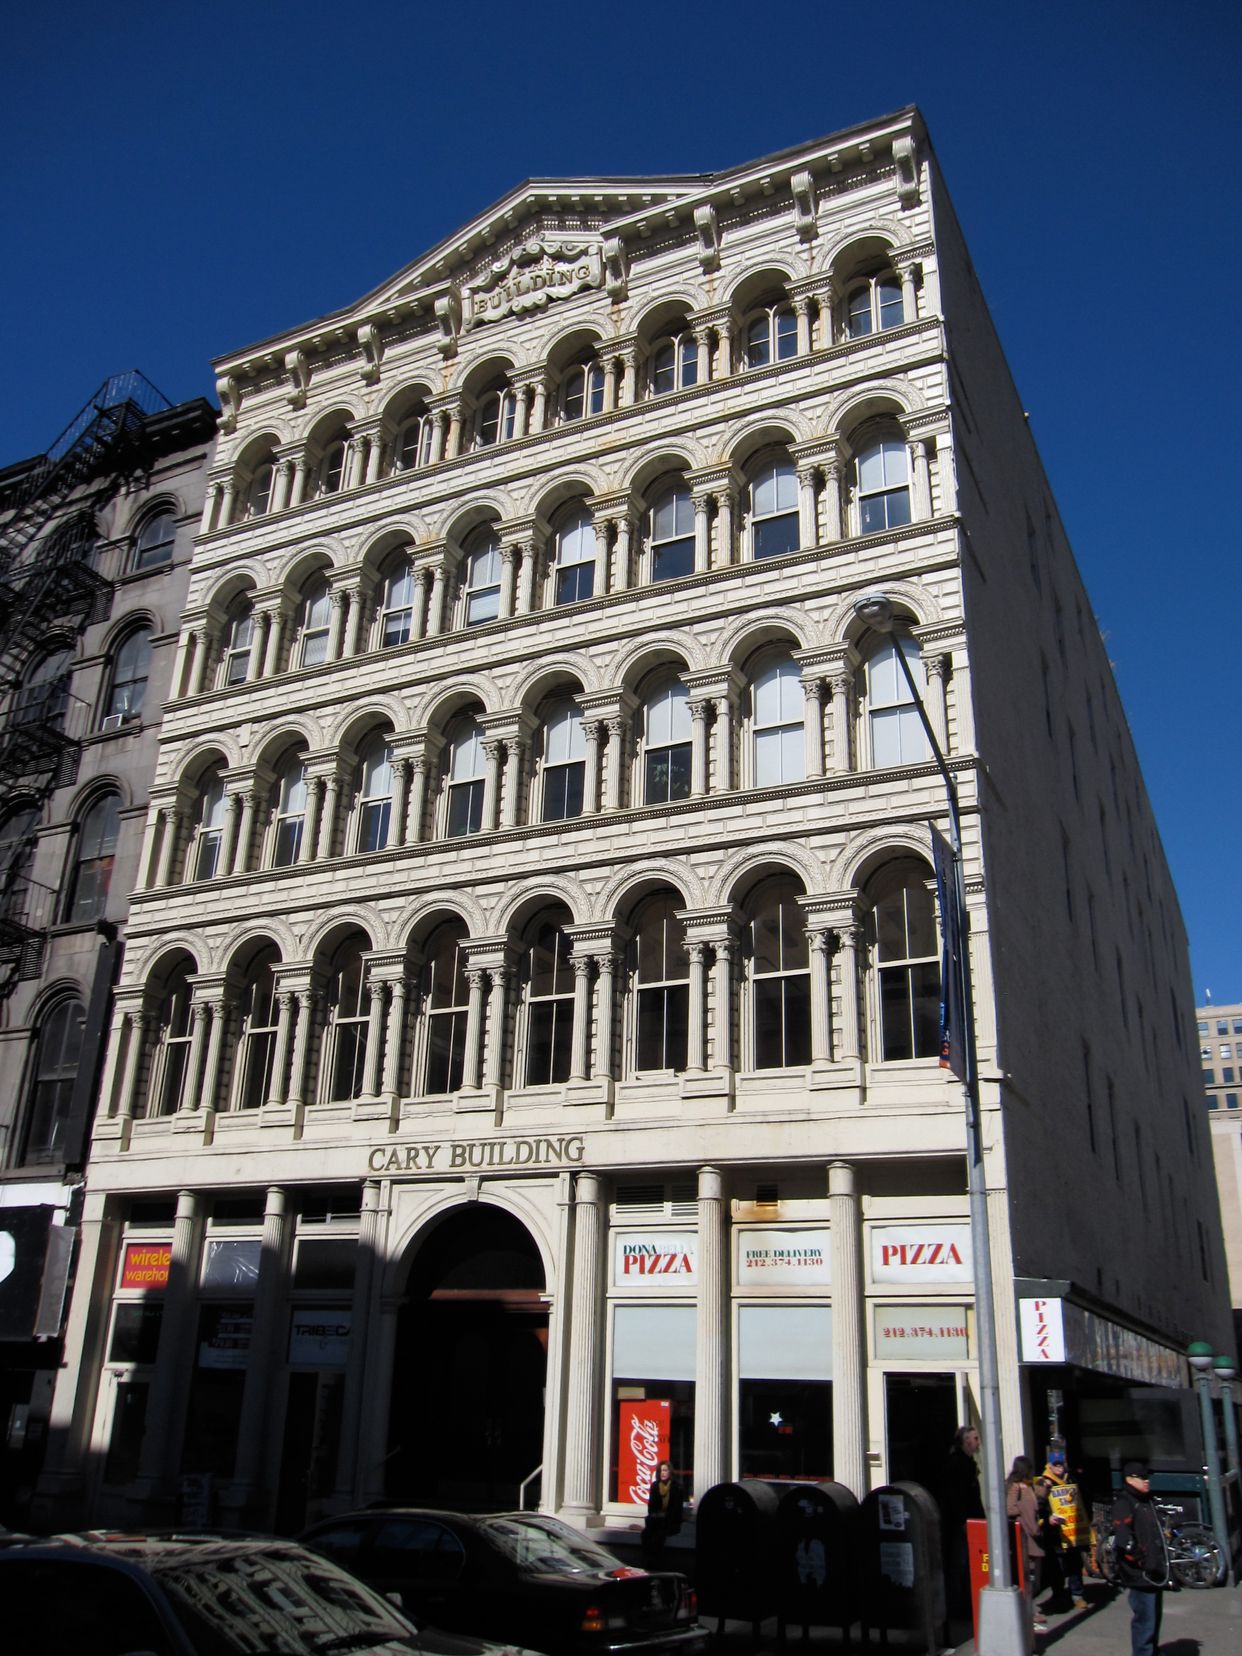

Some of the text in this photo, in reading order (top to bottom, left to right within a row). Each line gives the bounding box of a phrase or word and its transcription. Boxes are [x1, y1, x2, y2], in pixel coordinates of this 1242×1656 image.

[474, 264, 591, 315] BUILDING
[368, 1136, 586, 1171] CARY BUILDING
[130, 1249, 172, 1266] wirele
[623, 1253, 693, 1275] PIZZA
[746, 1248, 823, 1258] FREE DELIVERY
[746, 1258, 823, 1268] 212.374.1130
[881, 1243, 963, 1266] PIZZA
[125, 1267, 169, 1281] wareho
[1034, 1300, 1050, 1360] PIZZA
